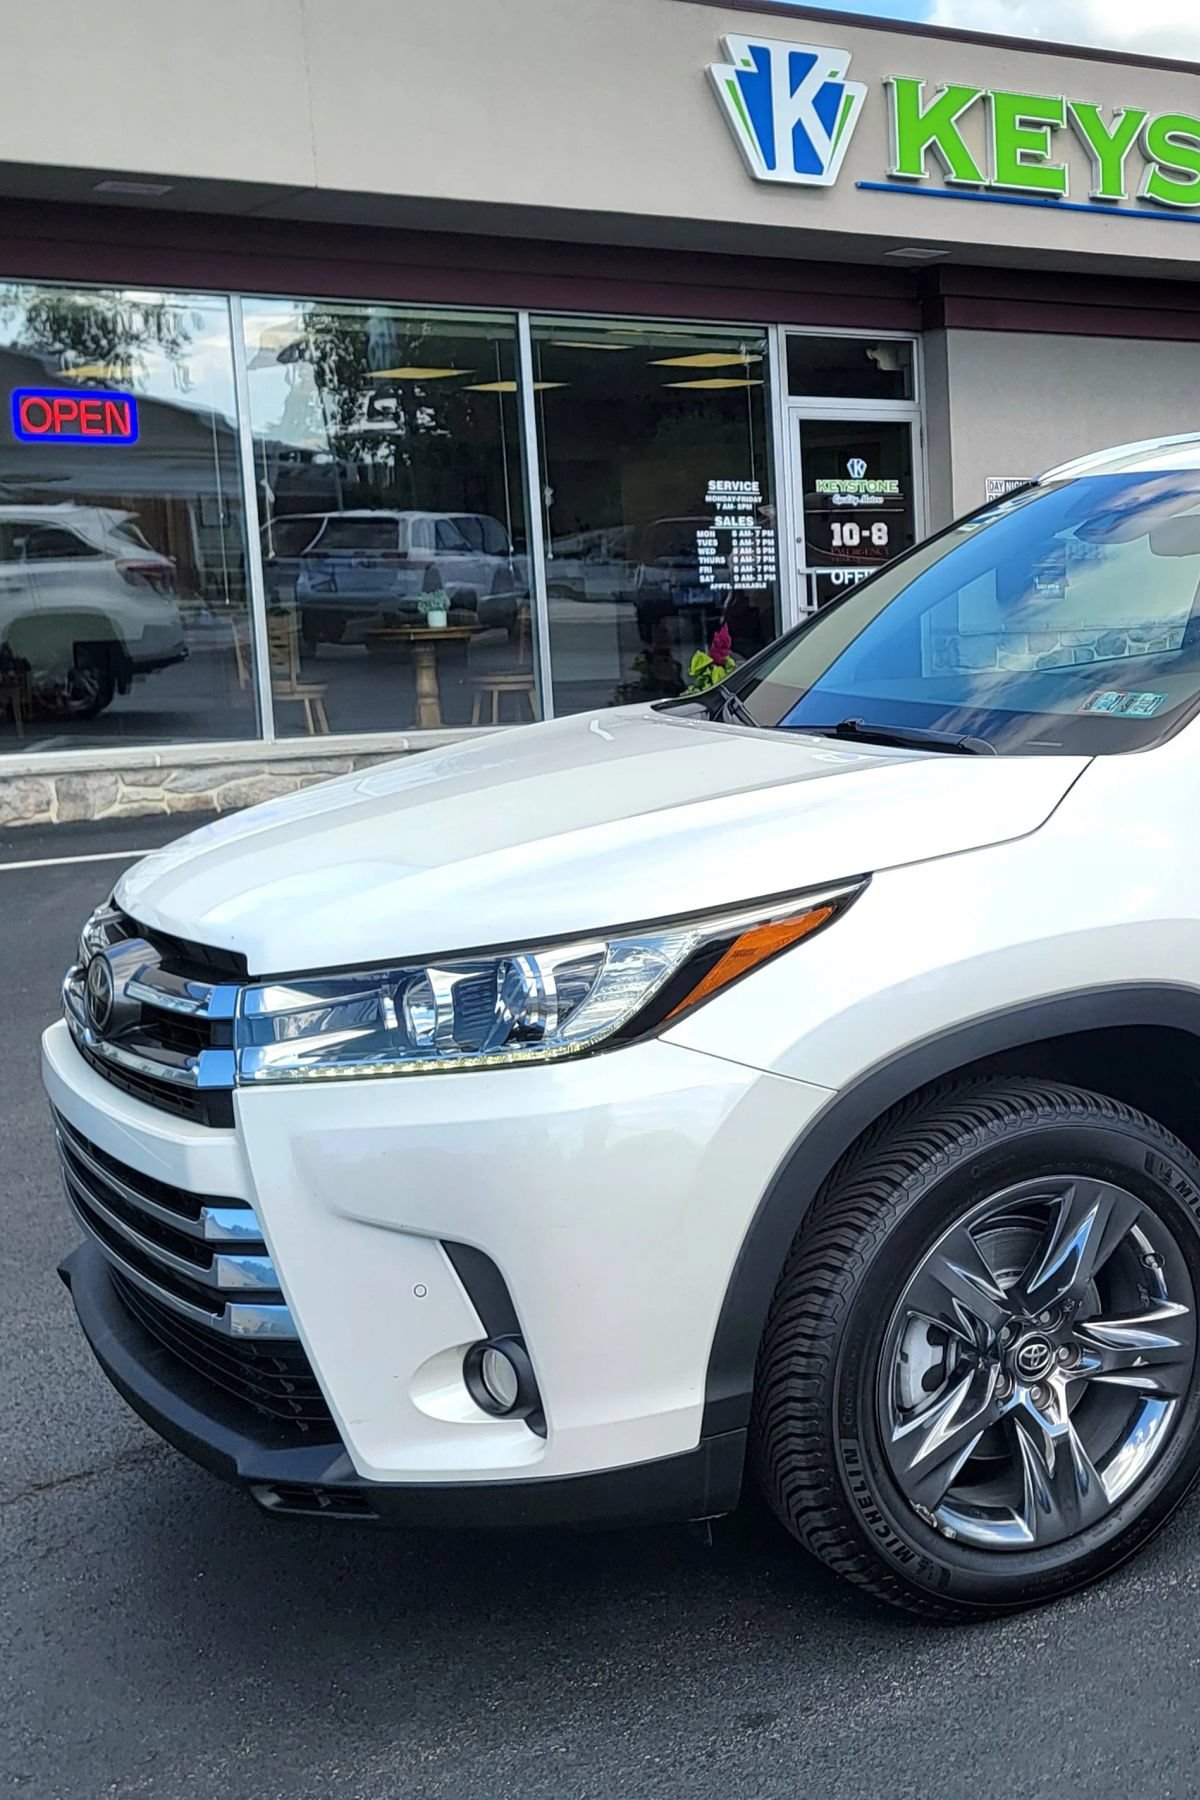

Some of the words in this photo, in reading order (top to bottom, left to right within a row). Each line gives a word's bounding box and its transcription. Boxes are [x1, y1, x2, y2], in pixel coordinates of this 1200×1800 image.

[20, 397, 131, 436] OPEN
[708, 480, 760, 491] SERVICE
[815, 479, 899, 493] KEYSTONE
[989, 481, 1004, 492] DAY
[705, 495, 763, 503] MONDAY-FRIDAY
[714, 516, 754, 527] SALES
[696, 530, 716, 538] MON
[831, 522, 888, 546] 10-8
[697, 539, 718, 547] TUES
[763, 547, 775, 555] PM
[698, 556, 726, 564] THURS
[756, 556, 761, 564] 7
[763, 556, 776, 564] PM
[699, 575, 715, 583] SAT
[764, 574, 777, 582] PM
[843, 1448, 916, 1564] MICHELIN
